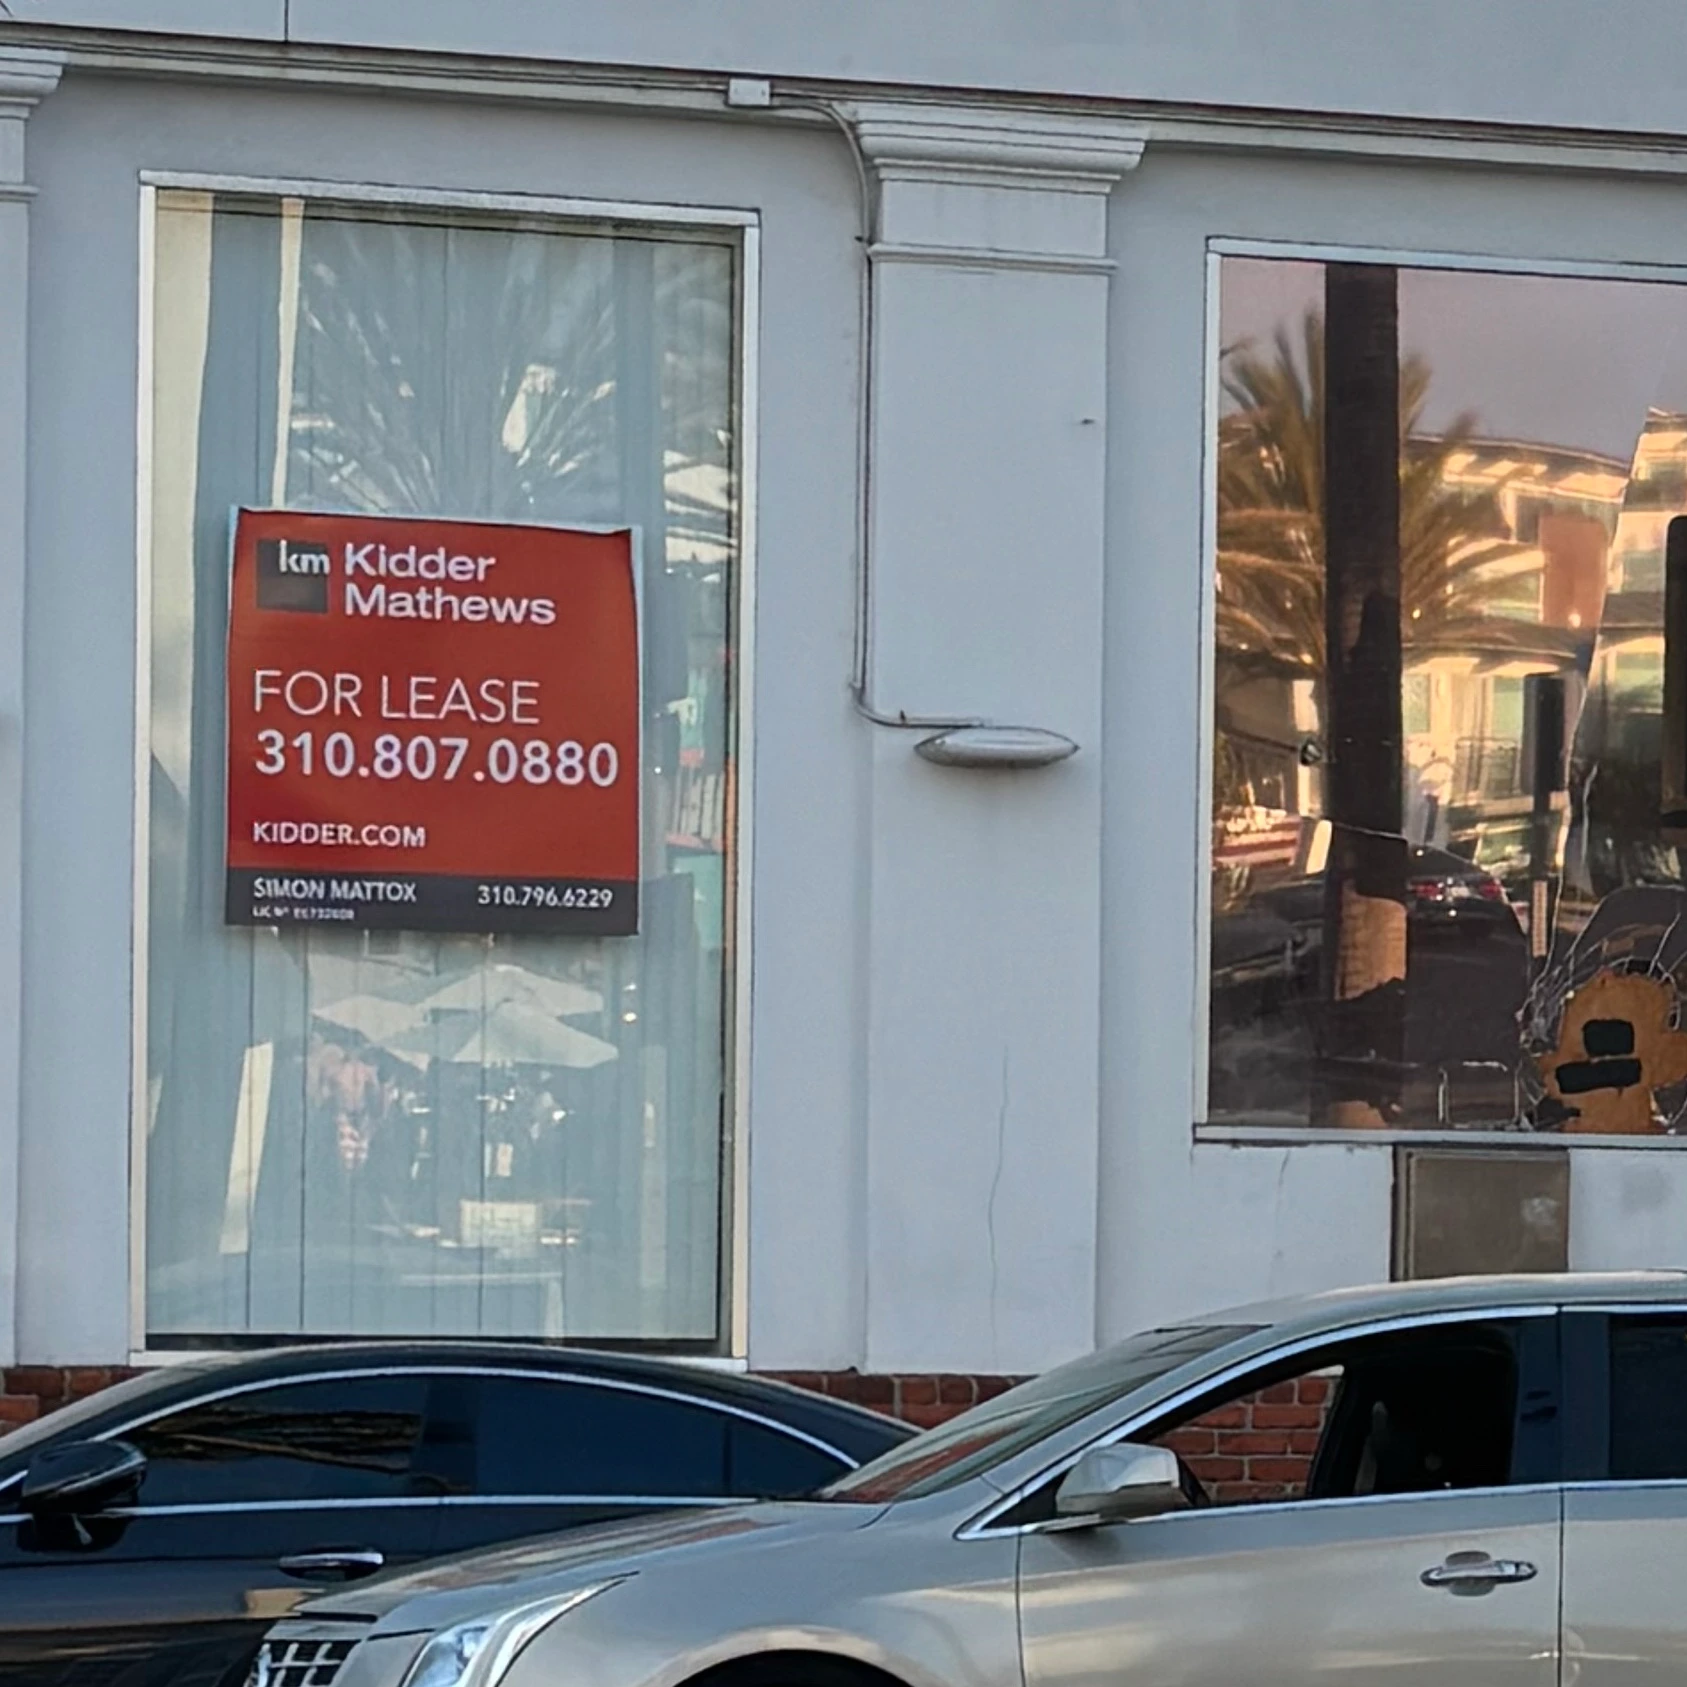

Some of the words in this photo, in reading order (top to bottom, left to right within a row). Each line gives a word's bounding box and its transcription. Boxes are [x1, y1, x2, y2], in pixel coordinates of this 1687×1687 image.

[279, 540, 330, 574] km
[344, 543, 496, 581] Kidder
[344, 584, 556, 625] Mathews
[254, 670, 362, 717] FOR
[381, 675, 540, 725] LEASE
[254, 729, 618, 787] 310.807.0880
[253, 822, 425, 848] KIDDER.COM
[254, 877, 325, 900] SIMON
[330, 879, 417, 903] MATTOX
[477, 884, 613, 908] 310.796.6229
